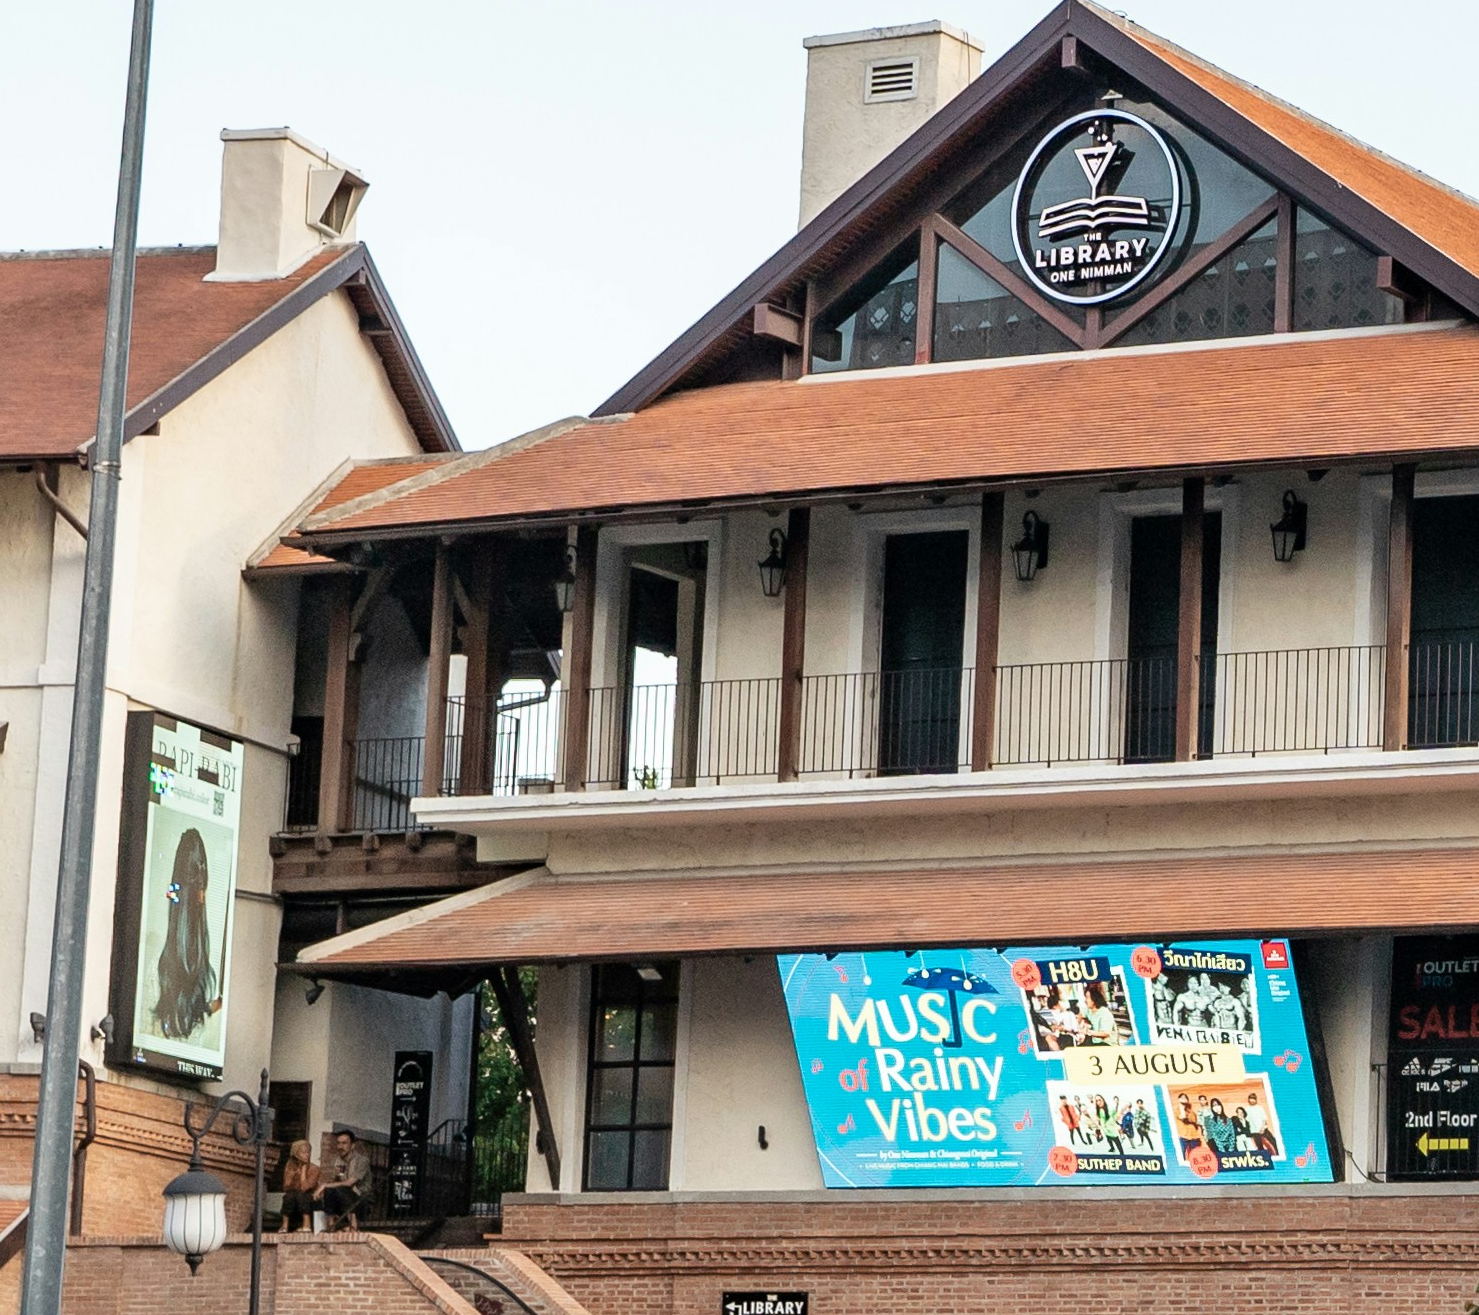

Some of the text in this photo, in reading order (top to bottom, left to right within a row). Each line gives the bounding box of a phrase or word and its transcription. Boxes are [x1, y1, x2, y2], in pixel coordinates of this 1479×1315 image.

[1083, 233, 1102, 242] THE
[1035, 237, 1148, 268] LIBRARY
[1050, 262, 1133, 283] ONE NIMMAN
[1048, 959, 1099, 983] H8U
[1423, 959, 1479, 974] OUTLET
[838, 1048, 1004, 1101] of Rainy
[1089, 1052, 1218, 1076] 3 AUGUST
[865, 1091, 998, 1142] Vibes
[1405, 1110, 1478, 1128] 2nd Floor
[1077, 1157, 1161, 1172] SUTHEP BAND
[743, 1301, 804, 1315] LIBRARY
